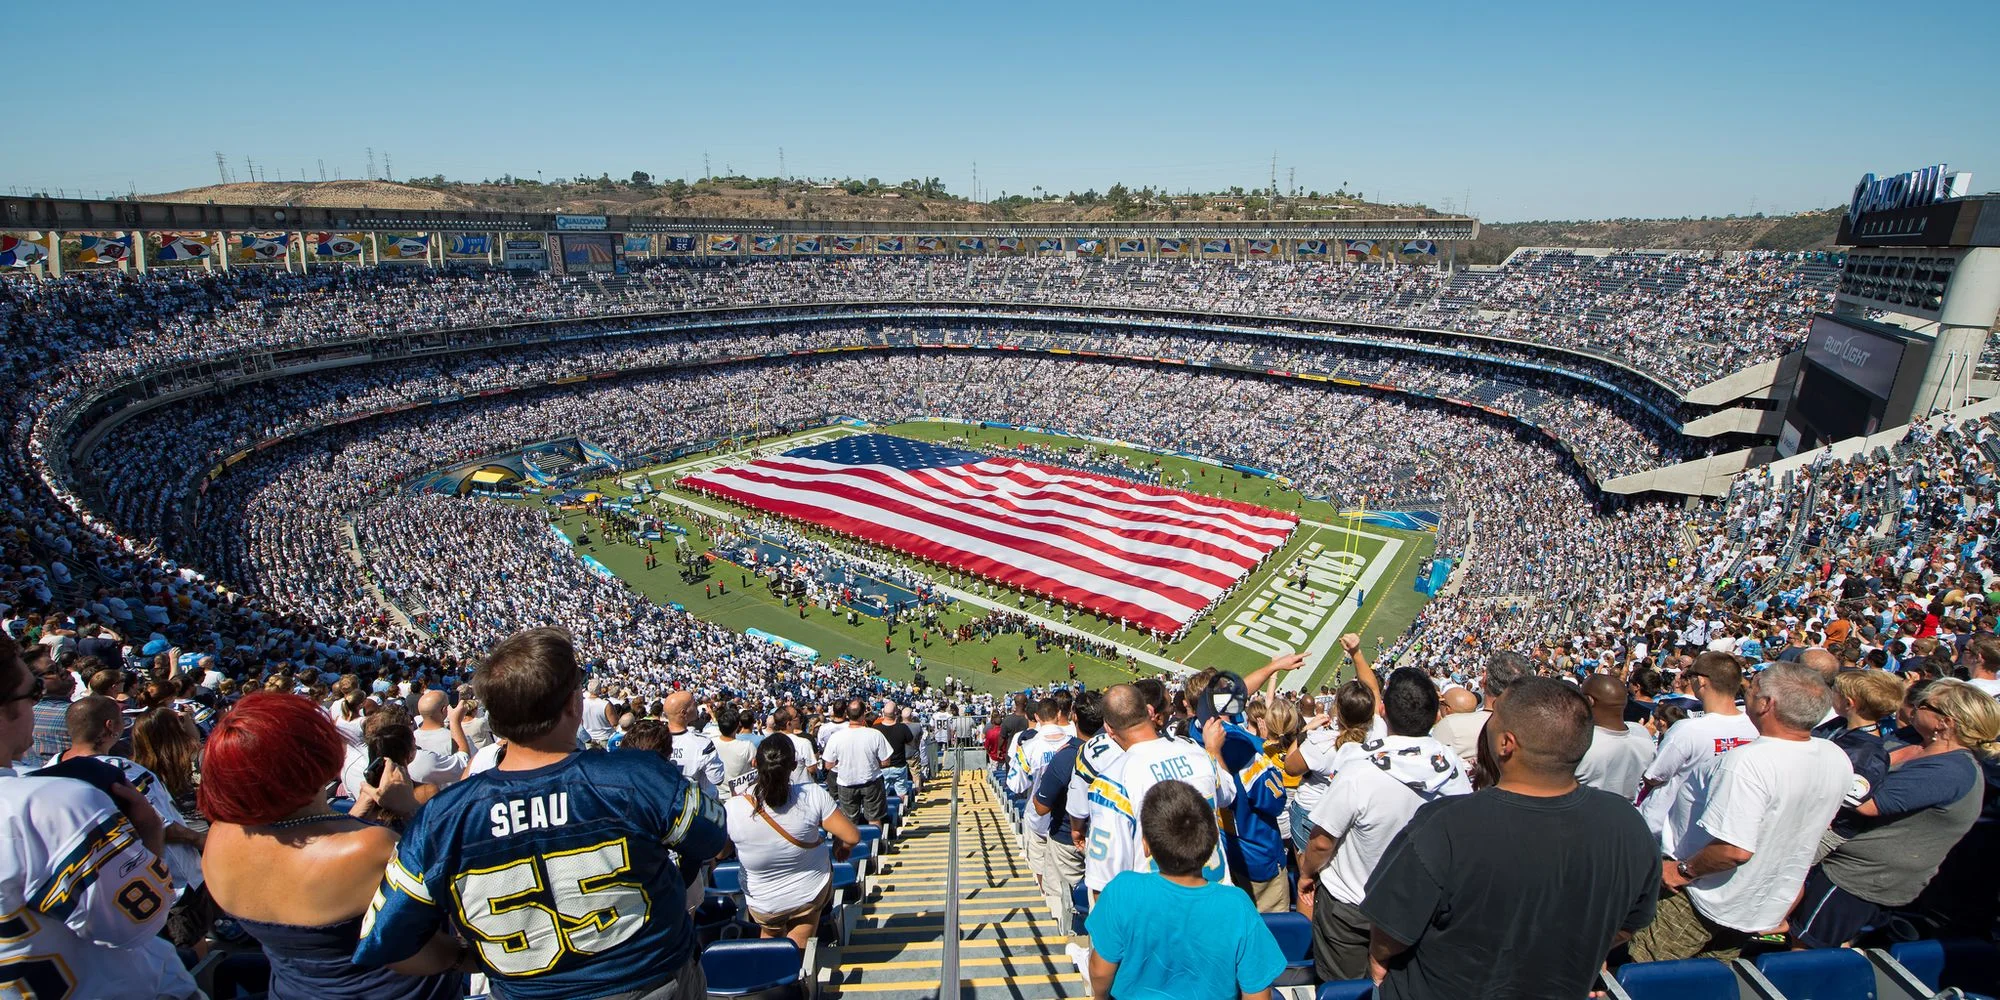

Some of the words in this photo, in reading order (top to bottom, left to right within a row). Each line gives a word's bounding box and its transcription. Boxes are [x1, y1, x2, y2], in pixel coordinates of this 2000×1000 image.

[1863, 217, 1928, 233] STADIUM
[676, 243, 687, 251] 55
[1824, 335, 1842, 355] BUD
[1843, 343, 1870, 367] LIGHT
[1223, 576, 1340, 661] DIEGO
[1088, 733, 1110, 759] 54
[1150, 755, 1194, 782] GATES
[490, 792, 568, 838] SEAU
[451, 837, 652, 976] 55
